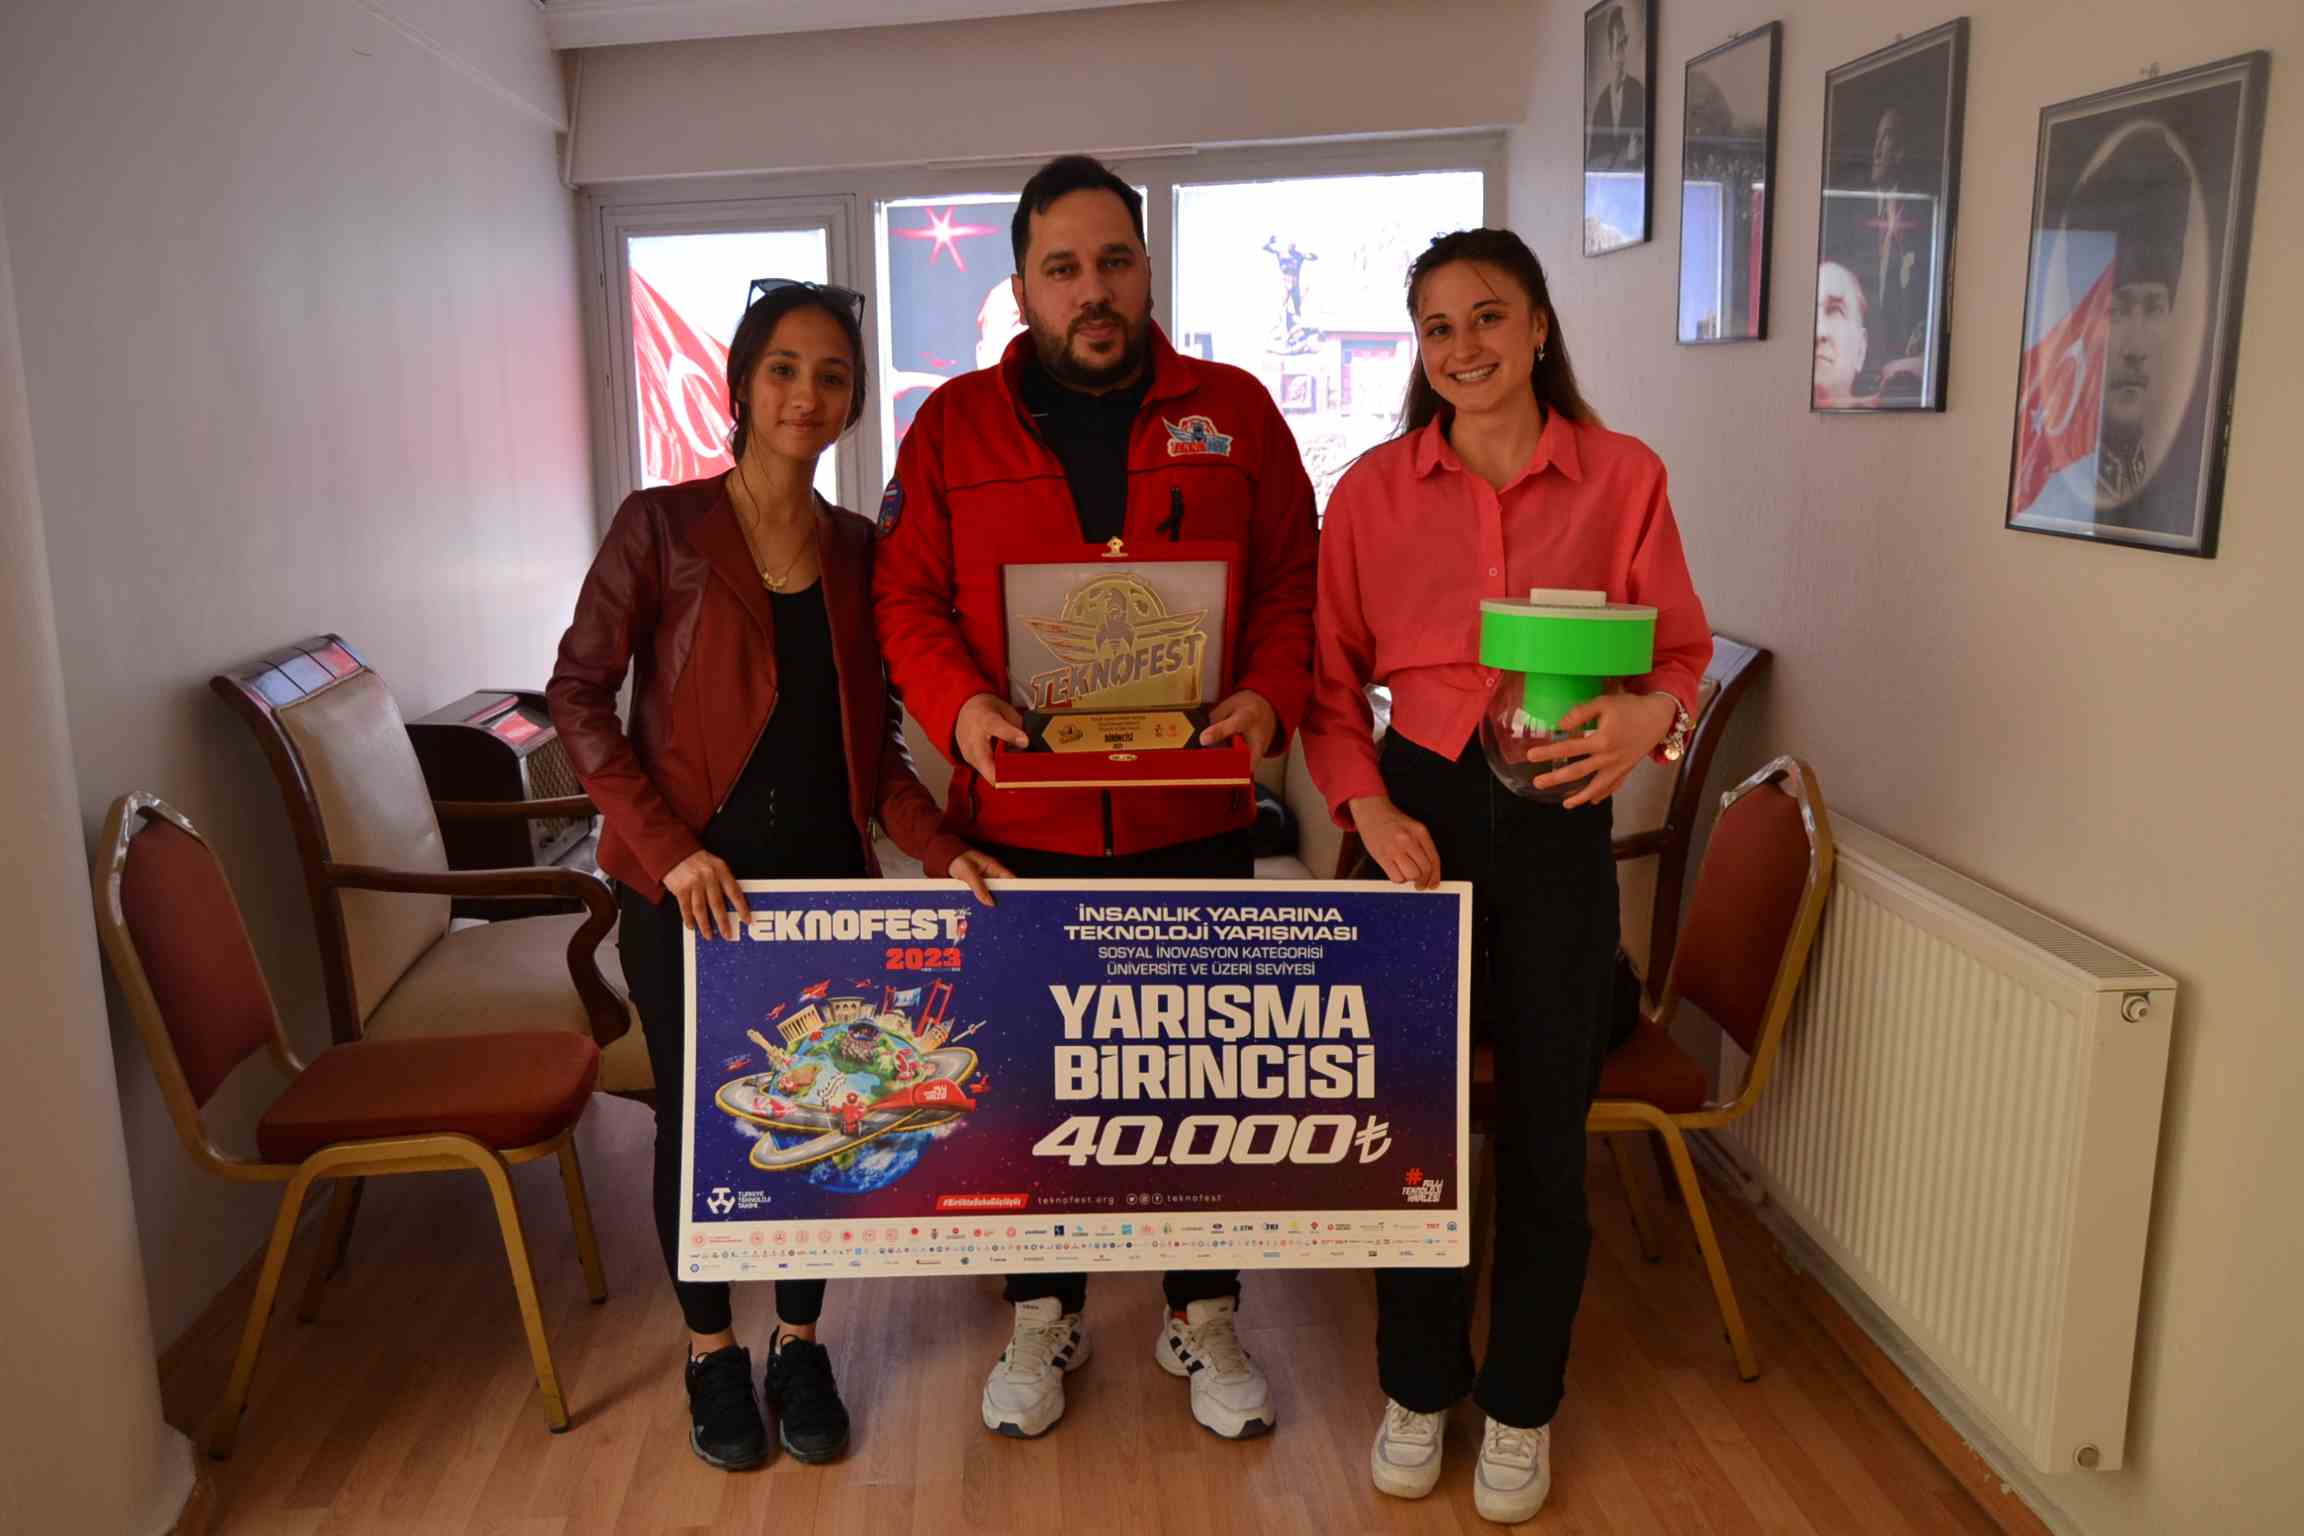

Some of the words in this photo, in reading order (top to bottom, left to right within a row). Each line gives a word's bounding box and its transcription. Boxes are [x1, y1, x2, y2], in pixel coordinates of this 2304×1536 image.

[1032, 634, 1202, 707] TEKNOFEST
[1079, 904, 1201, 923] İNSANLIK
[1206, 907, 1343, 923] YARARINA
[1064, 922, 1209, 942] TEKNOLOJİ
[1213, 925, 1358, 945] YARIŞMASI
[886, 947, 961, 971] 2023
[1098, 946, 1153, 959] SOSYAL
[1156, 944, 1239, 959] İNOVASYON
[1242, 944, 1323, 959] KATEGORİSİ
[1106, 962, 1187, 976] ÜNİVERSİTE
[1190, 963, 1208, 976] VE
[1211, 962, 1252, 976] ÜZERİ
[1255, 962, 1315, 976] SEVİYESİ
[1049, 984, 1370, 1042] YARIŞMA
[1054, 1044, 1375, 1100] BİRİNCİSİ
[1037, 1195, 1115, 1206] teknofest.org
[1167, 1194, 1224, 1203] teknofest
